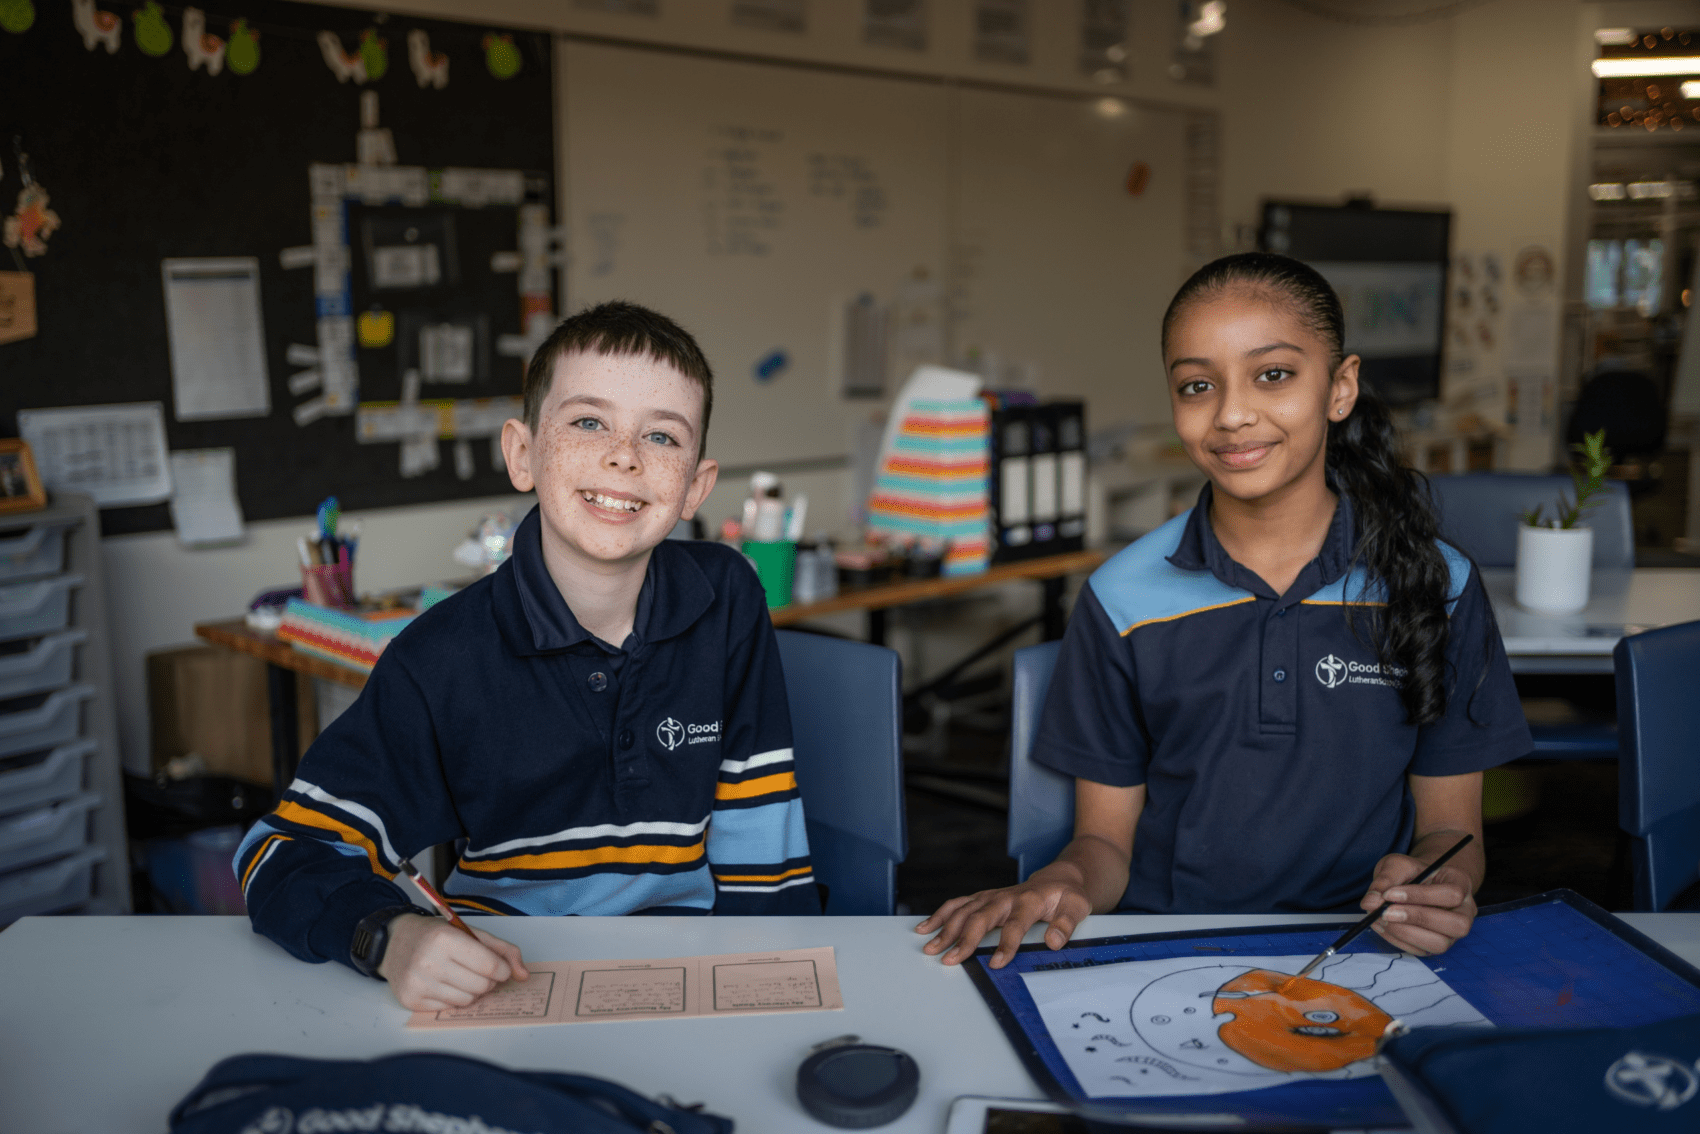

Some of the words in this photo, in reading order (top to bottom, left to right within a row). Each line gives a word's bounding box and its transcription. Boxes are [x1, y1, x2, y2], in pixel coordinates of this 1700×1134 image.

[1348, 661, 1380, 673] Good
[1348, 675, 1378, 684] Lutheran
[687, 720, 718, 734] Good
[688, 735, 717, 744] Lutheran
[297, 1102, 385, 1134] Good
